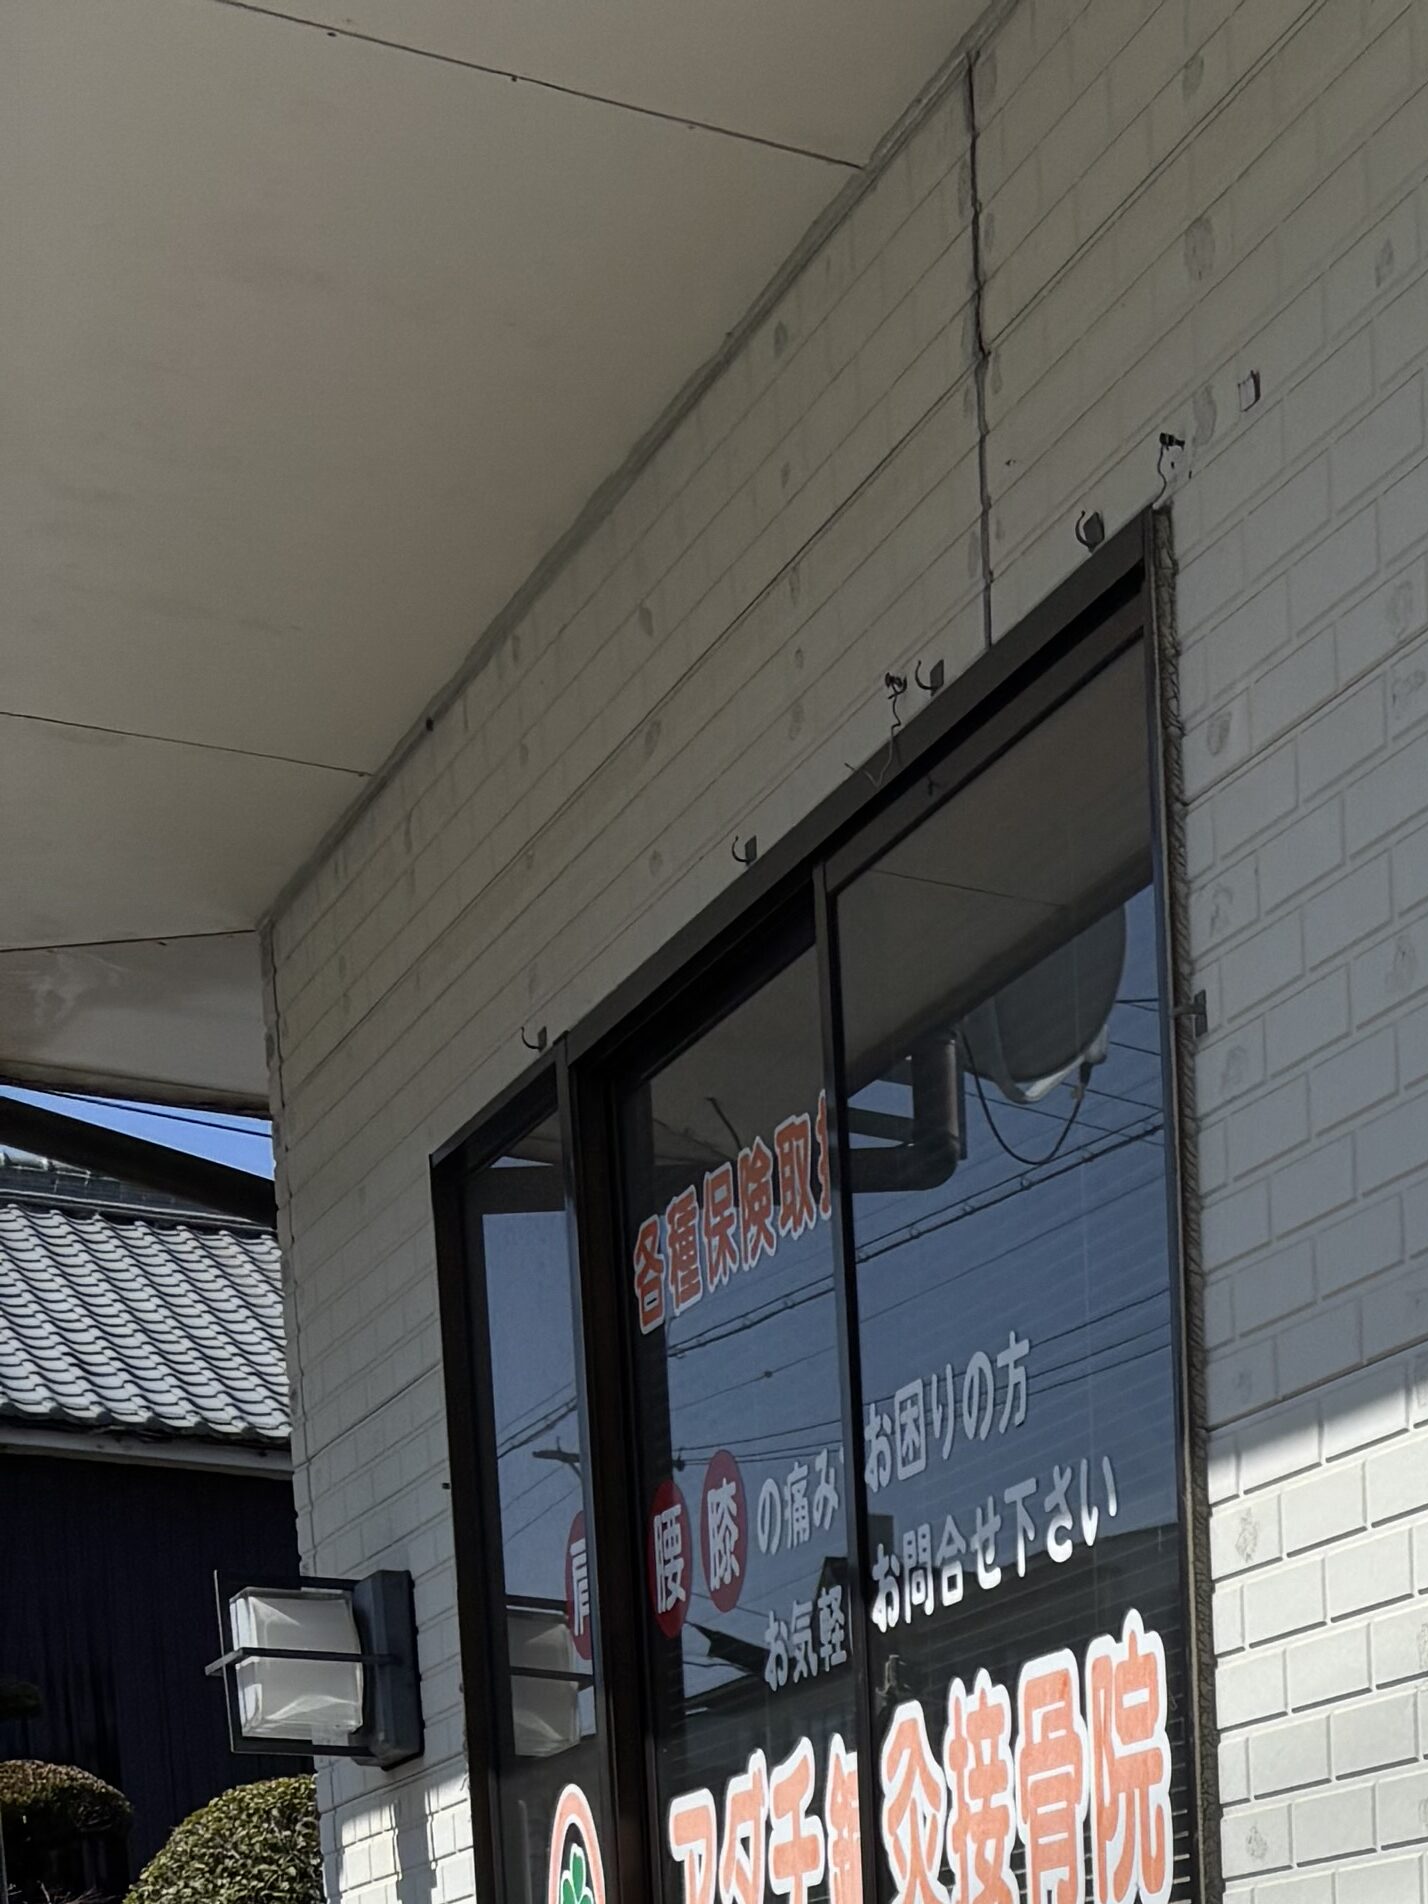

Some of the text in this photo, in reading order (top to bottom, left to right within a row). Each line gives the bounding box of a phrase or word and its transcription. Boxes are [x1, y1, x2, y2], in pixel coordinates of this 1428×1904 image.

[633, 1088, 833, 1335] 各種保険取
[757, 1446, 844, 1554] の痛み
[864, 1330, 1030, 1493] お困りの方
[764, 1455, 1118, 1692] お気軽 お問合せ下さい
